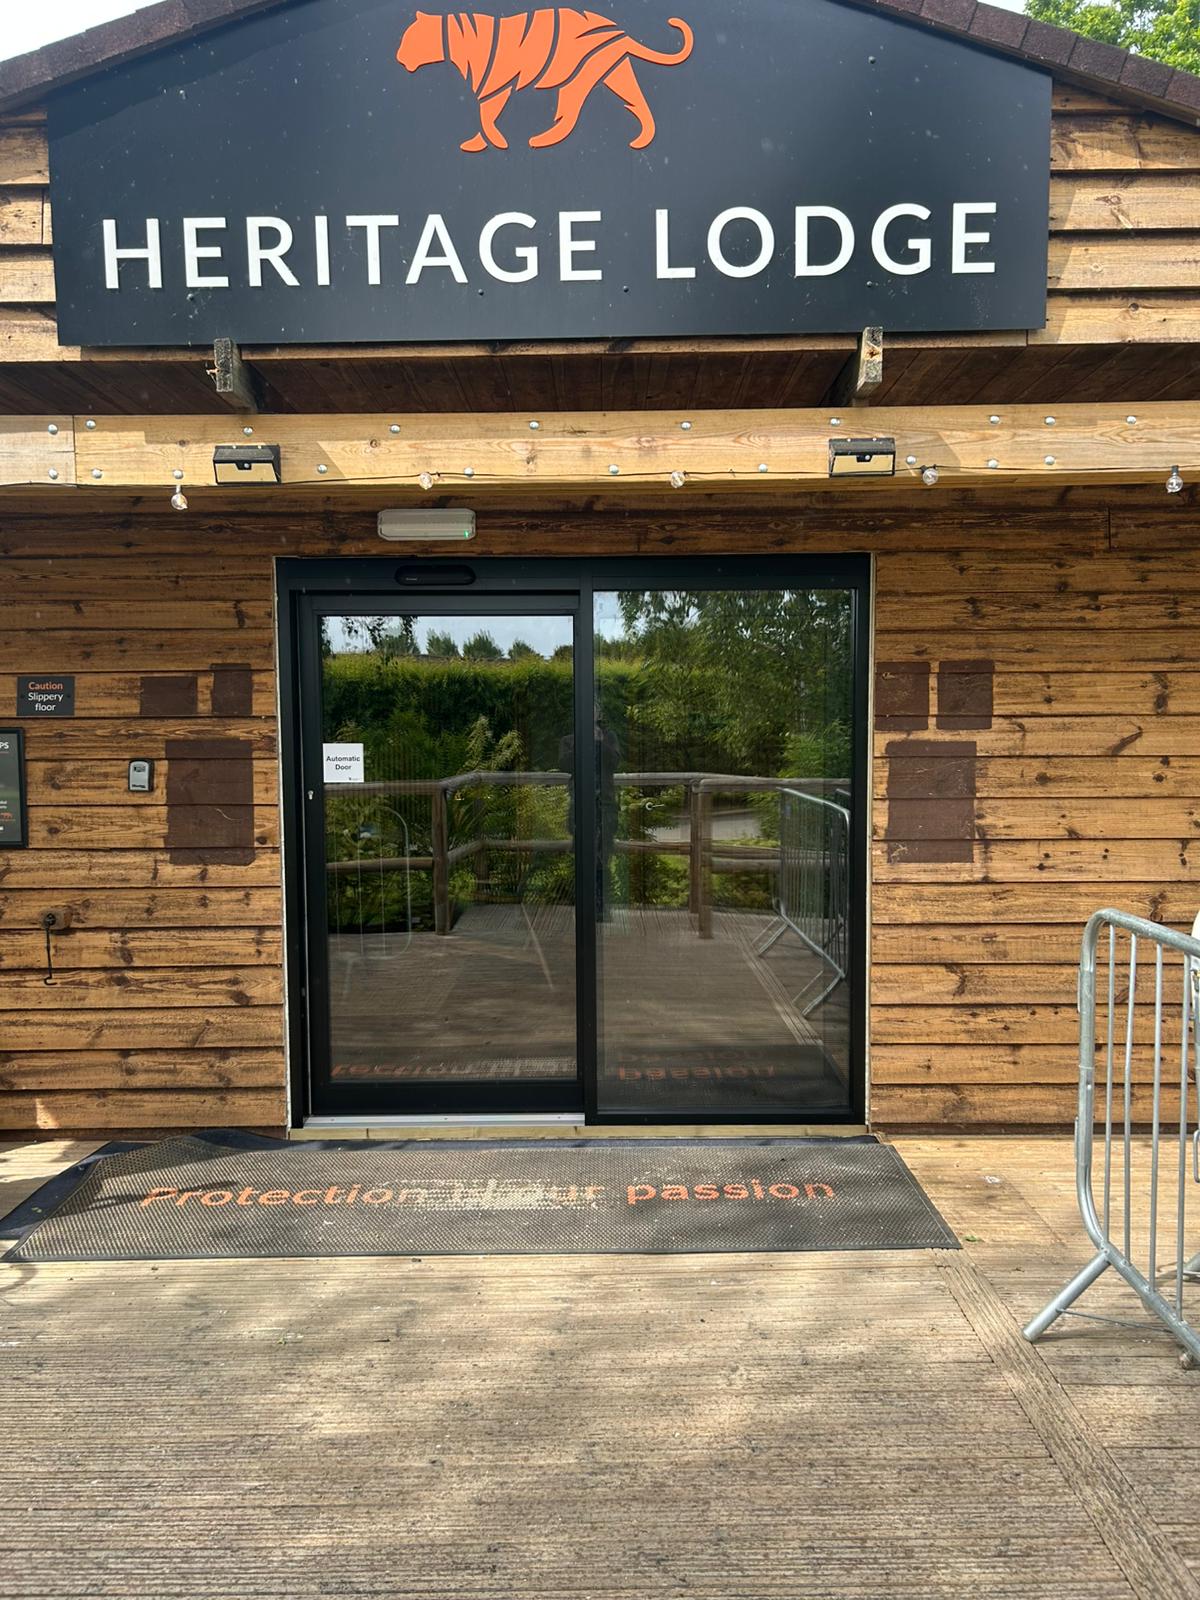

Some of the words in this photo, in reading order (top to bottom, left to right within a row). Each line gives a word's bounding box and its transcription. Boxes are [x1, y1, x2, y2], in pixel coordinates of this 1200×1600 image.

[101, 209, 604, 291] HERITAGE
[654, 200, 998, 281] LODGE
[28, 681, 64, 690] Caution
[28, 692, 64, 702] Slippery
[35, 703, 56, 711] floor
[139, 1183, 427, 1208] Protection
[626, 1178, 834, 1206] passion
